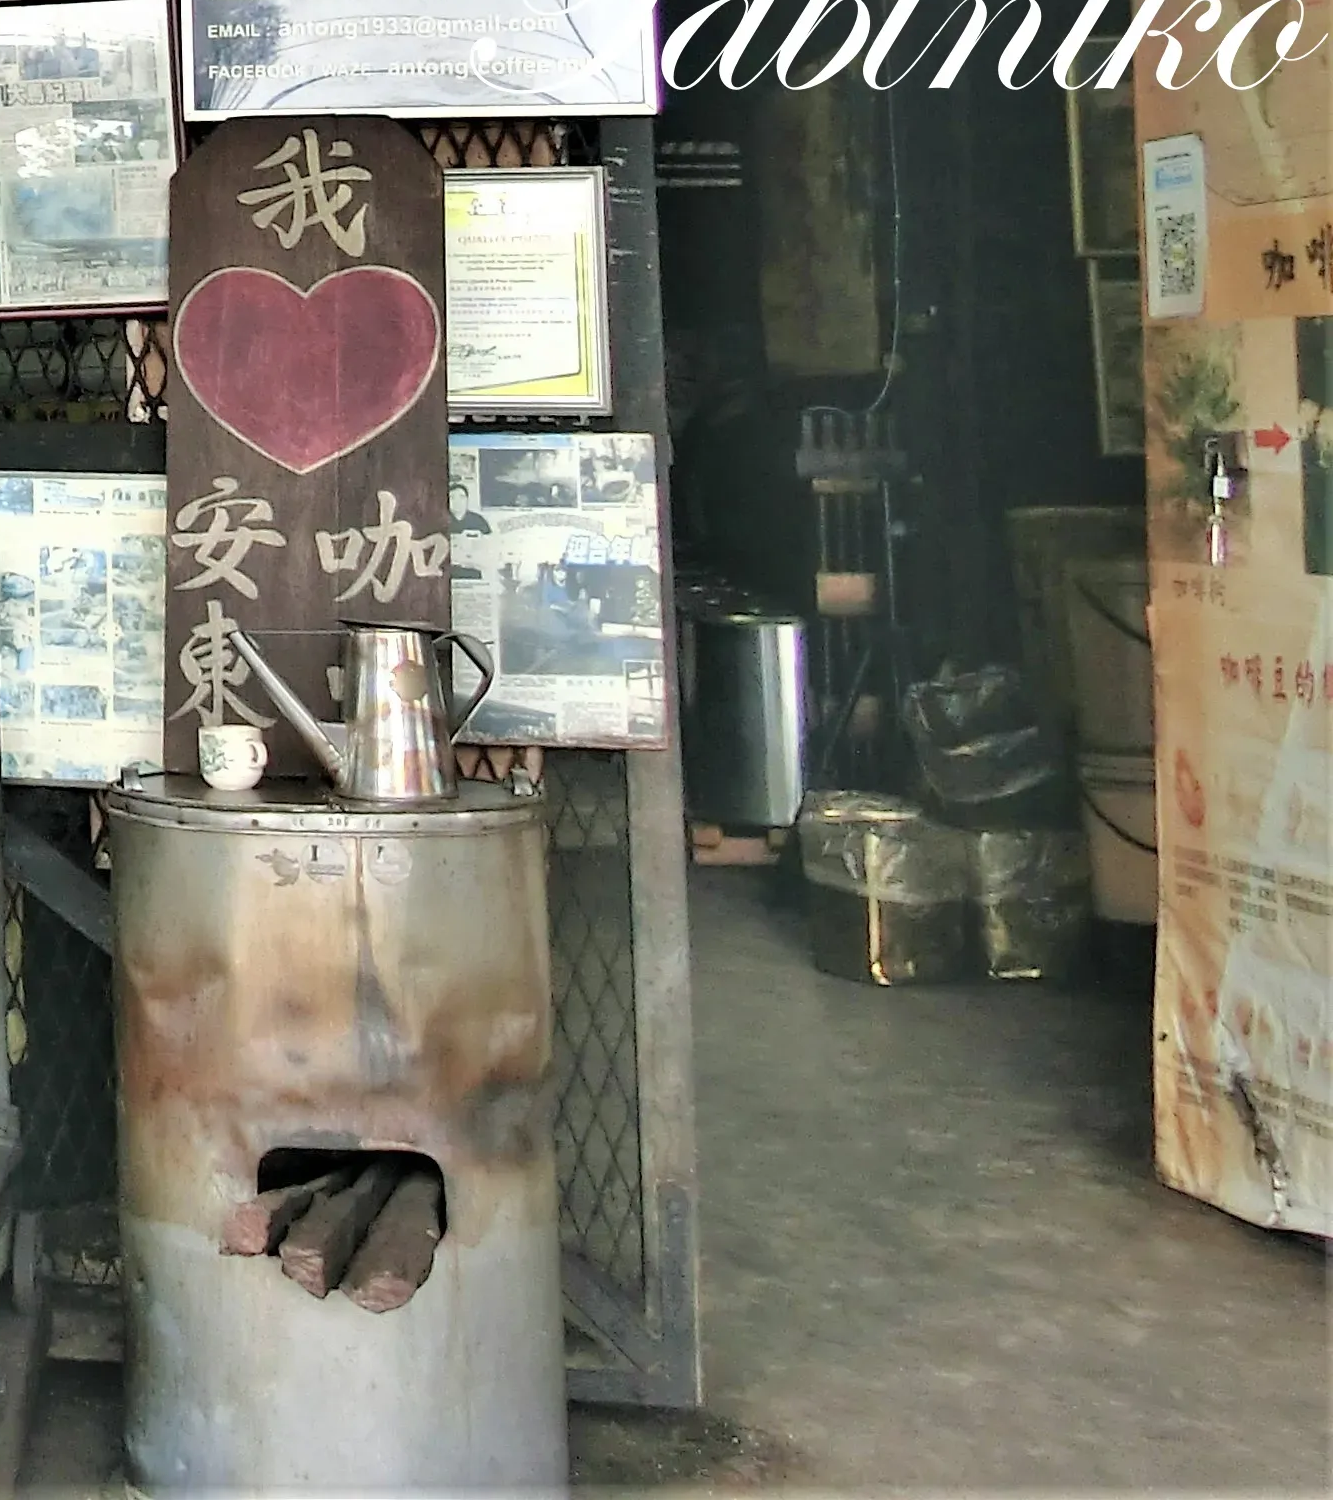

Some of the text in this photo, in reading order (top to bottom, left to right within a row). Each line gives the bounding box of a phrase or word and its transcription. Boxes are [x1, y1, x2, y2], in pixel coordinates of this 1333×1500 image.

[207, 24, 260, 39] EMAIL
[278, 15, 558, 39] antong1933@gmail.com
[237, 127, 372, 257] 我
